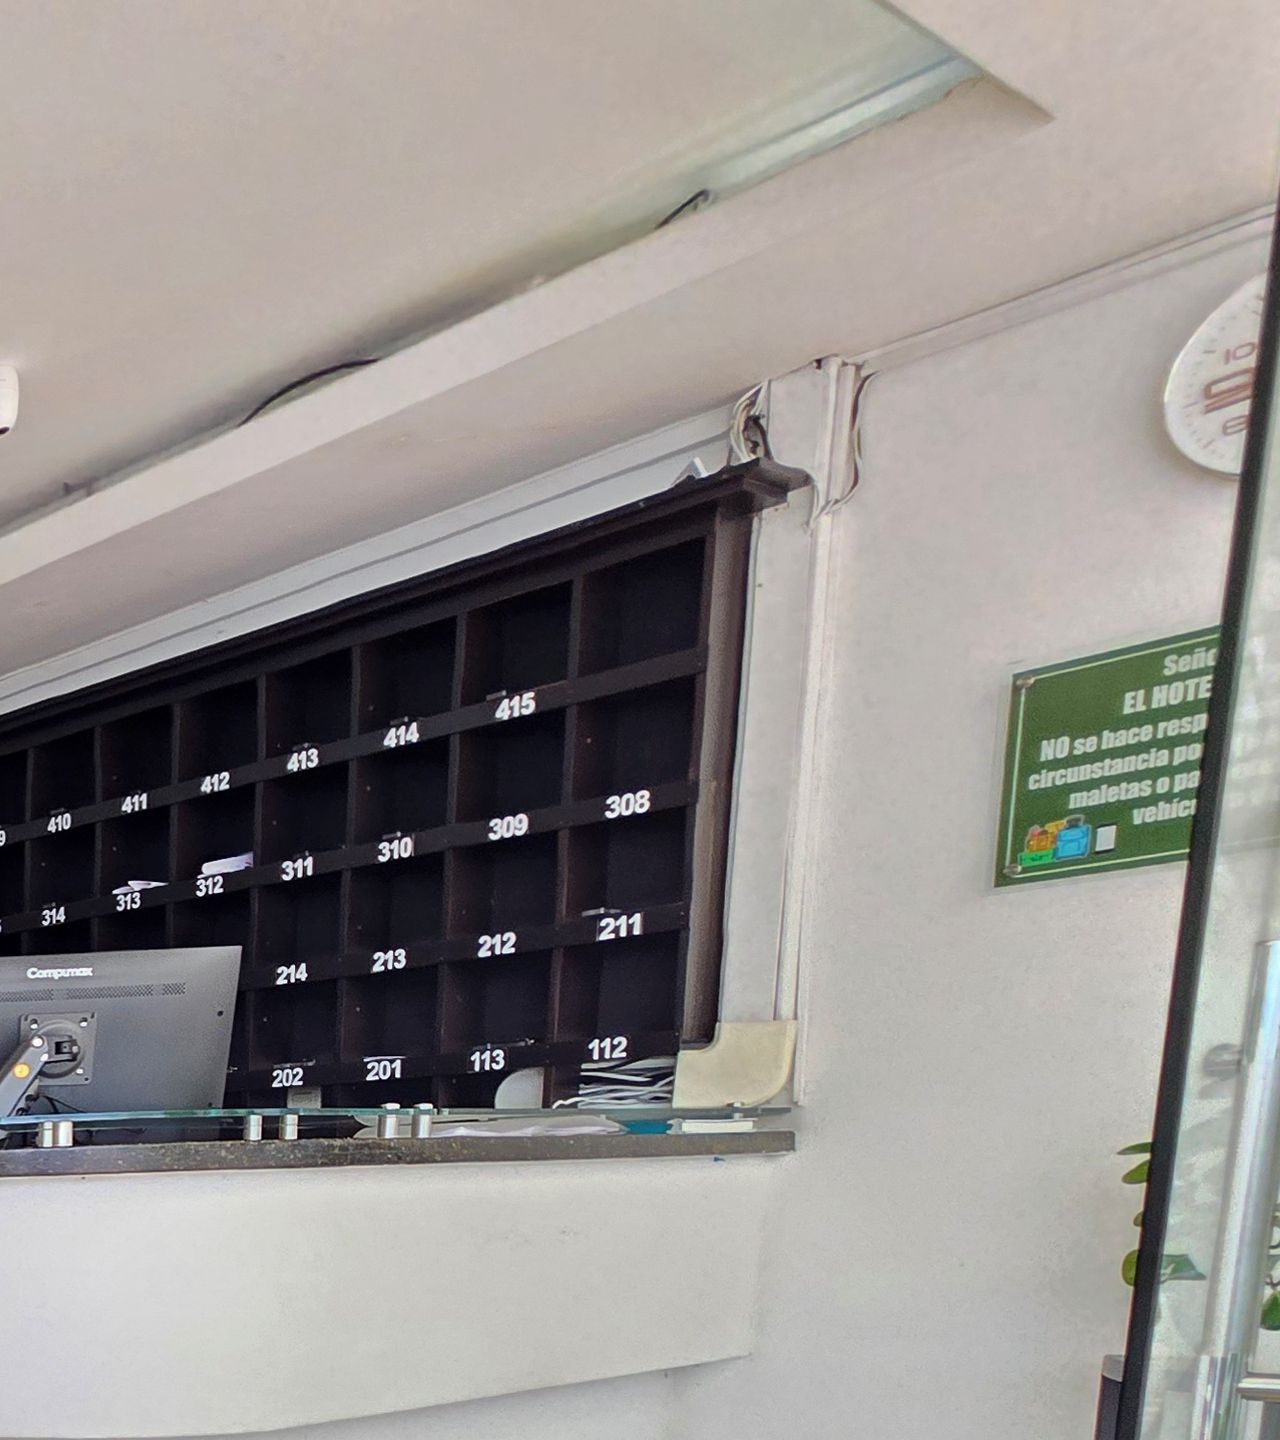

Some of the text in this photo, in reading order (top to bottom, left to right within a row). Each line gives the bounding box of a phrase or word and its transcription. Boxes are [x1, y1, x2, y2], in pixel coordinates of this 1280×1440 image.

[495, 691, 536, 720] 415
[1123, 689, 1147, 714] EL
[383, 722, 419, 748] 414
[1039, 735, 1070, 762] NO
[1073, 733, 1098, 754] se
[1101, 723, 1152, 750] hace
[287, 748, 319, 772] 413
[1028, 743, 1204, 790] circunstancia po
[201, 771, 230, 794] 412
[1069, 780, 1152, 809] maletas
[1155, 778, 1170, 794] o
[121, 793, 148, 814] 411
[604, 789, 650, 819] 308
[47, 813, 72, 833] 410
[488, 813, 529, 841] 309
[377, 836, 413, 863] 310
[281, 856, 314, 881] 311
[195, 876, 224, 897] 312
[116, 892, 141, 912] 313
[41, 906, 66, 926] 314
[598, 912, 642, 941] 211
[477, 931, 517, 958] 212
[370, 948, 407, 973] 213
[275, 963, 308, 986] 214
[470, 1049, 505, 1072] 113
[588, 1036, 628, 1060] 112
[271, 1067, 304, 1088] 202
[365, 1059, 402, 1081] 201
